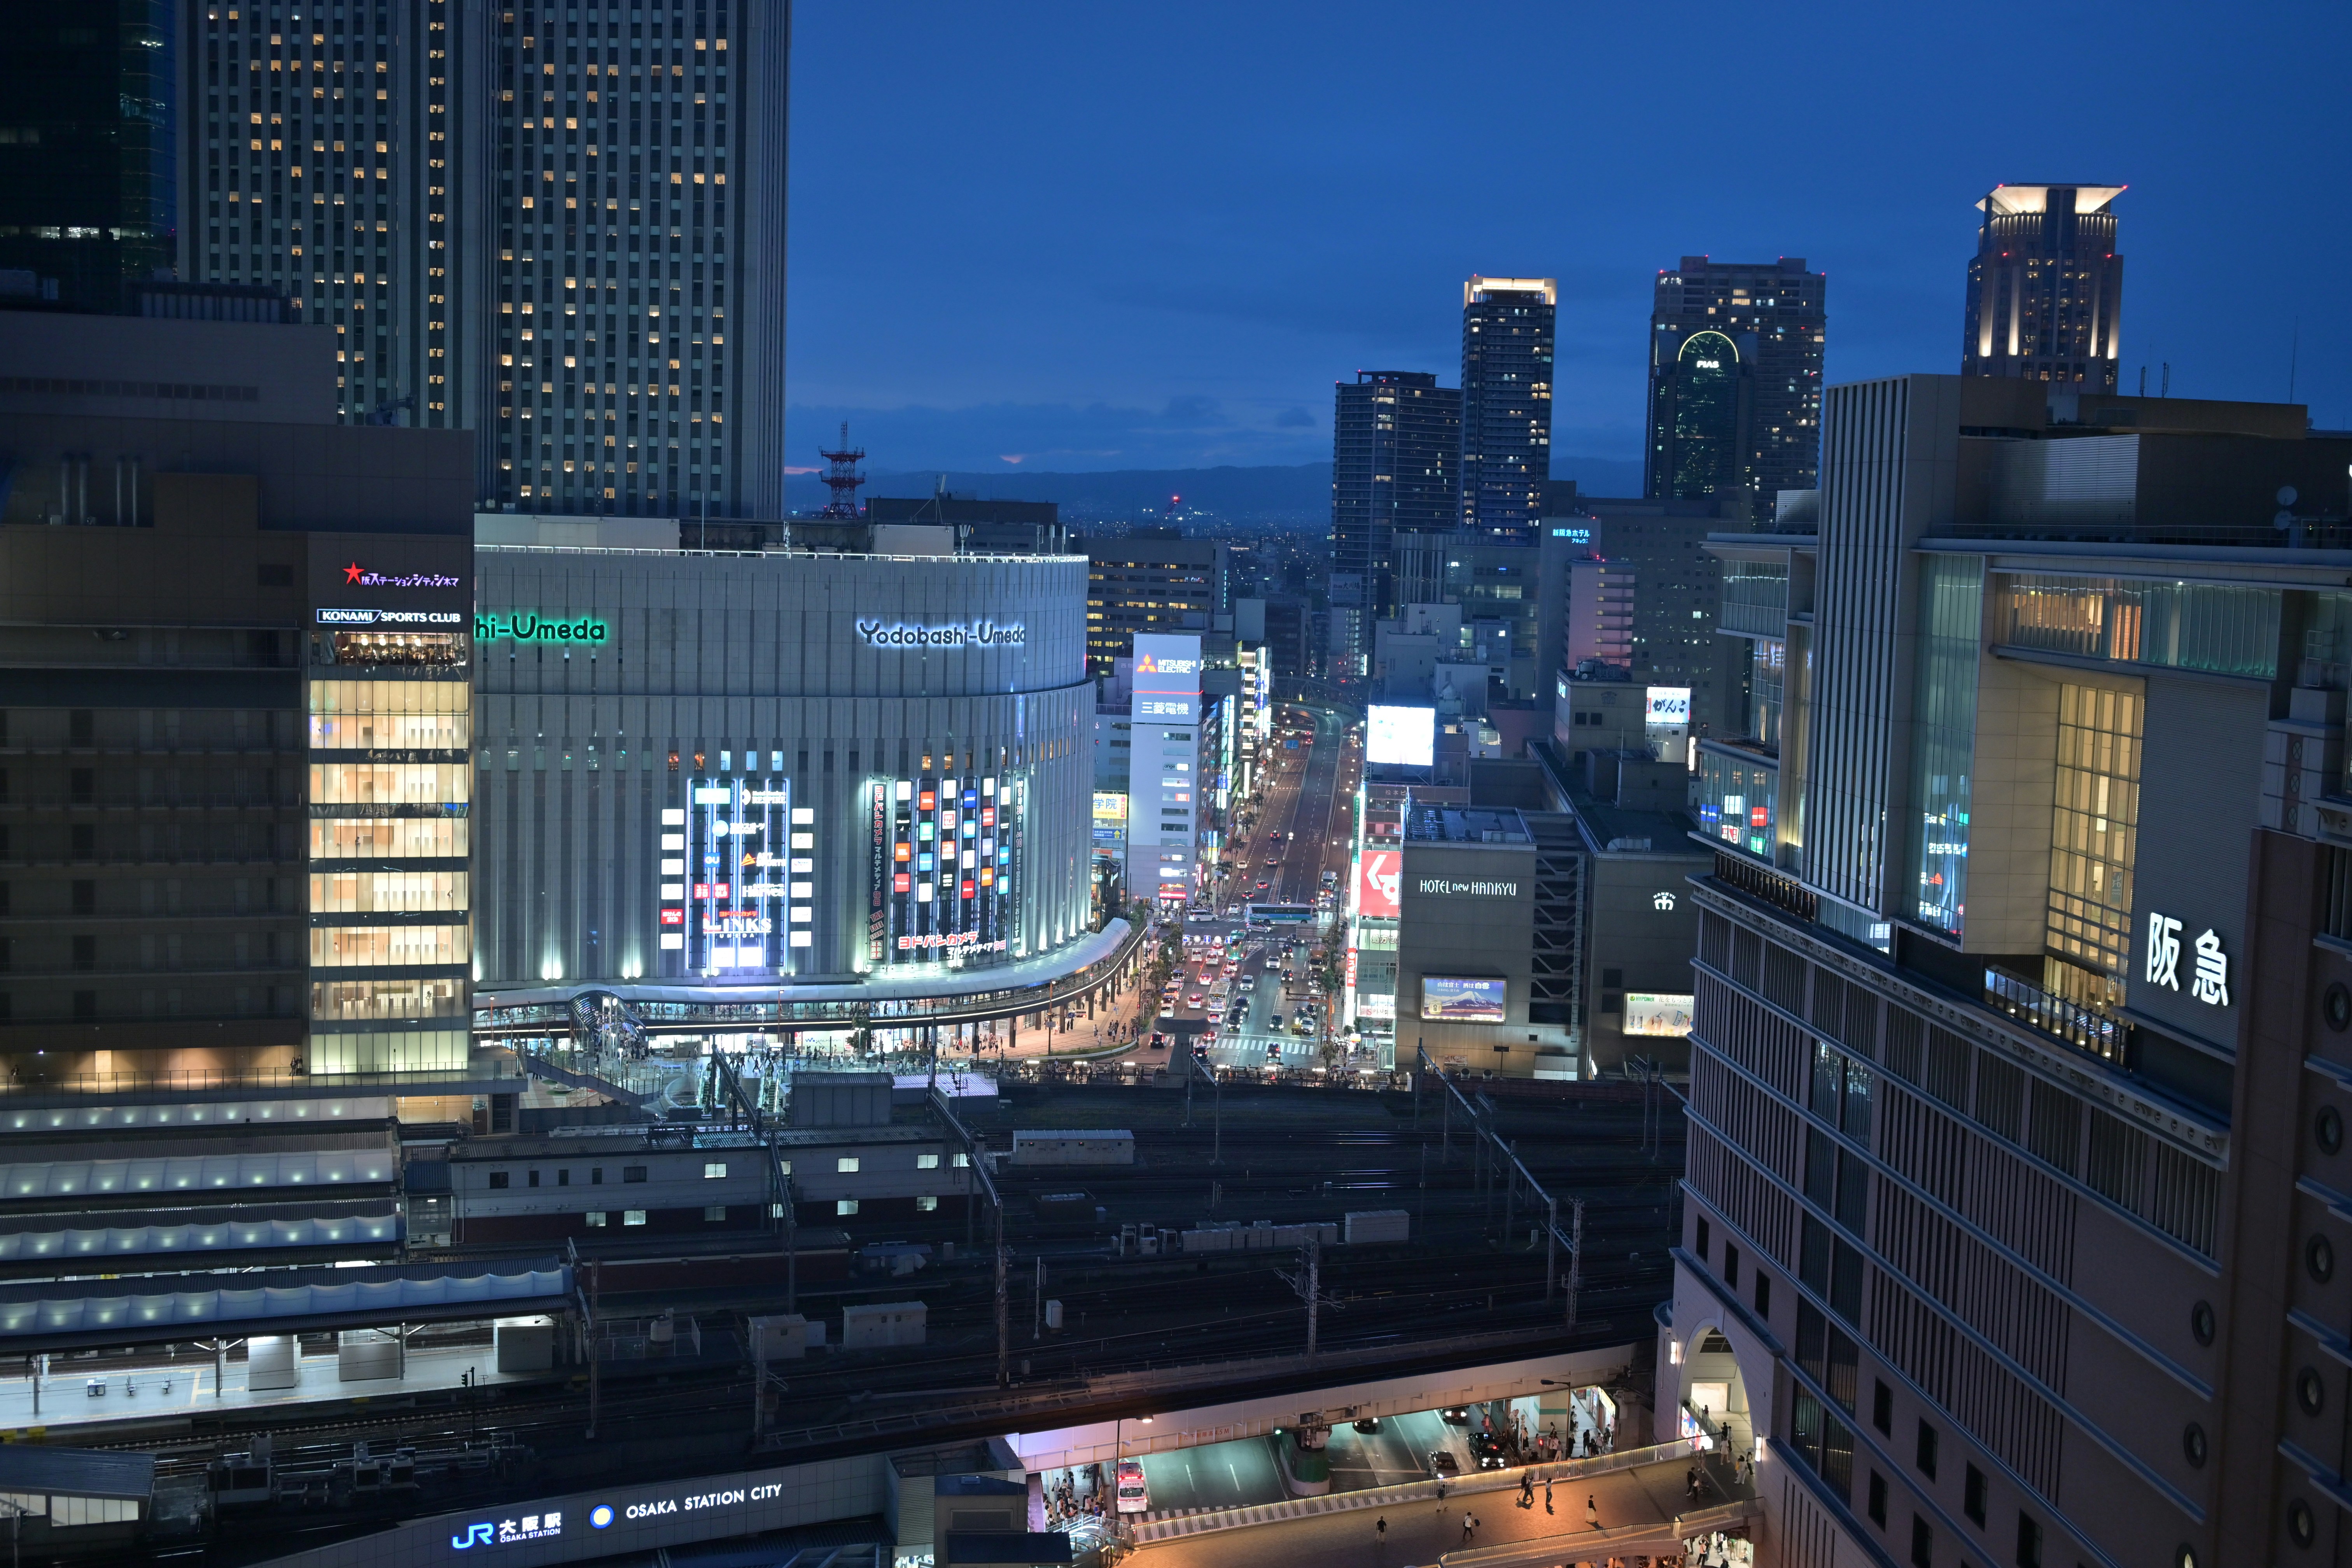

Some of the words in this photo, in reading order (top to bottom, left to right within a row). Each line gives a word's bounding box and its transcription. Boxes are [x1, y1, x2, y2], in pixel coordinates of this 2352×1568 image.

[1552, 528, 1590, 537] 新阪急ホテル
[322, 611, 373, 621] KONAMI
[380, 612, 427, 622] SPORTS
[429, 612, 461, 623] CLUB
[859, 622, 1026, 645] Yodobashi-Umeda
[1157, 659, 1196, 668] MITSUBISHI
[1141, 702, 1189, 715] 三菱電機
[1653, 698, 1686, 713] がんこ
[705, 856, 719, 864] GU
[741, 885, 785, 897] Harves
[1420, 879, 1451, 893] HOTEL
[1452, 883, 1469, 892] new
[1472, 881, 1516, 896] HANKYU
[869, 909, 884, 922] TAX
[703, 917, 772, 932] LINKS
[869, 920, 884, 933] FREE
[869, 929, 884, 940] STORE
[898, 931, 978, 949] ヨドバシカメラ
[2146, 911, 2230, 1006] 阪急
[626, 1499, 677, 1519] OSAKA
[684, 1489, 744, 1510] STATION
[751, 1484, 782, 1500] CITY
[499, 1512, 561, 1536] 大阪駅
[452, 1522, 494, 1549] JR
[528, 1528, 561, 1538] STATION
